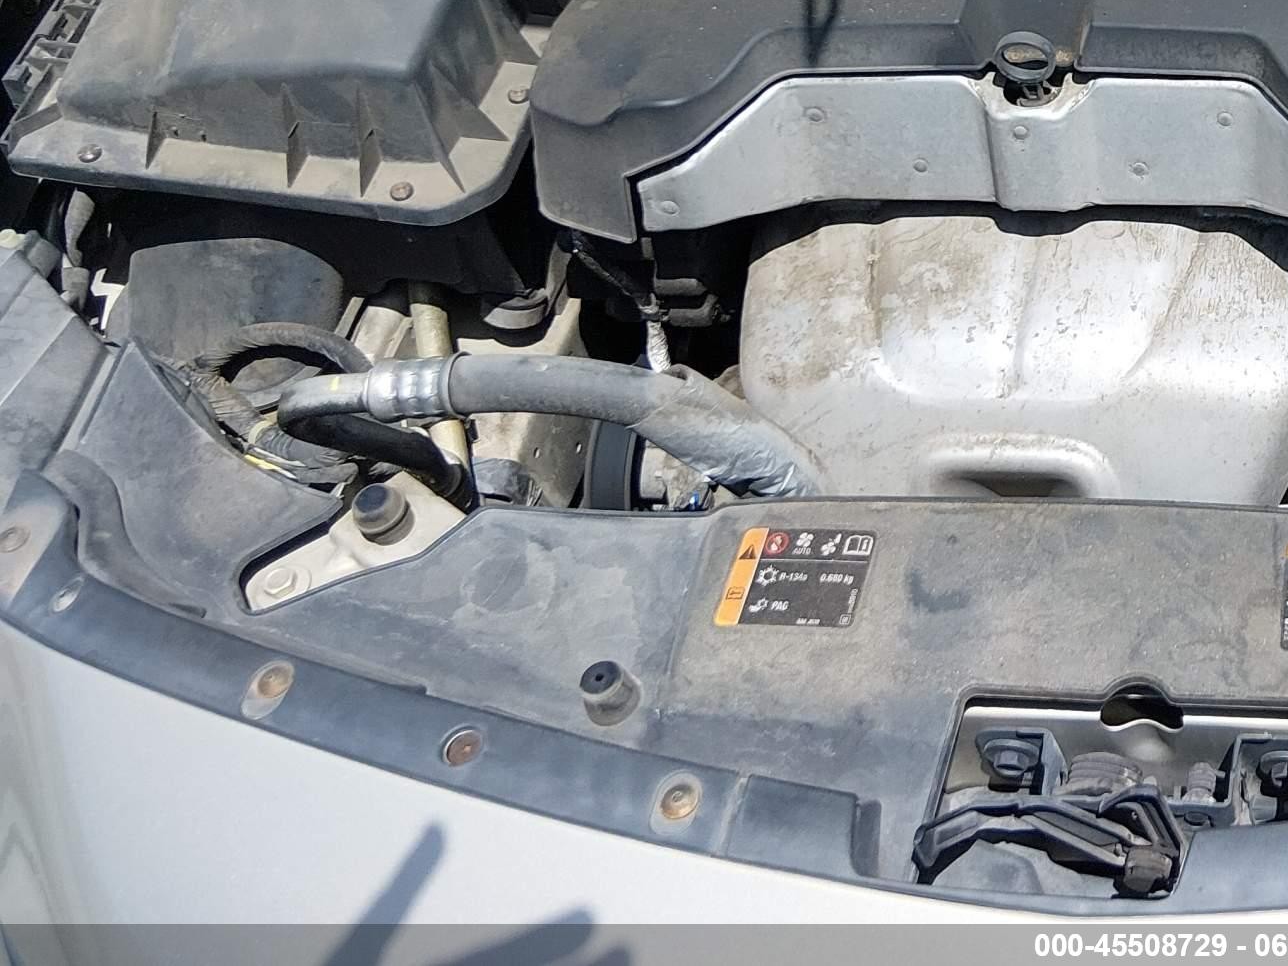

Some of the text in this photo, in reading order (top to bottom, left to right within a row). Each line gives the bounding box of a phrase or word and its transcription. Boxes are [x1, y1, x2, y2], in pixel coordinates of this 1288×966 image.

[792, 547, 811, 555] AUTO
[843, 574, 854, 586] kg
[770, 600, 790, 611] PAG
